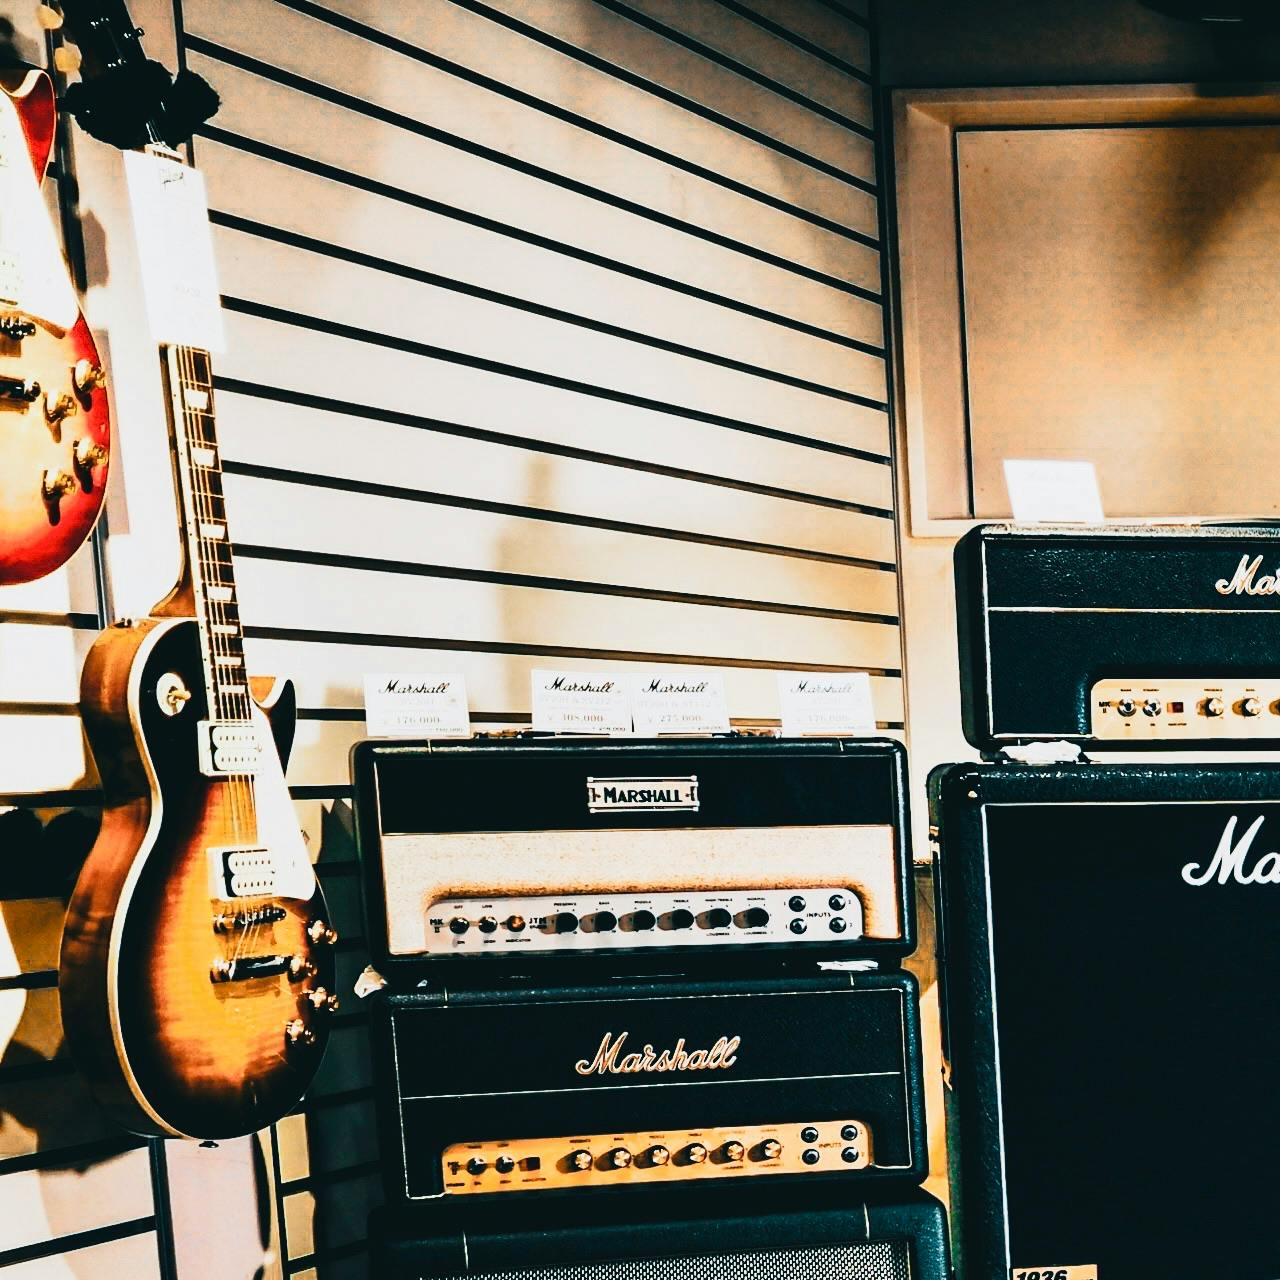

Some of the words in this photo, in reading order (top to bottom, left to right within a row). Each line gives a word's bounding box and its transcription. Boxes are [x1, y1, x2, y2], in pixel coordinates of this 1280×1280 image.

[378, 679, 451, 694] Marshall
[544, 676, 615, 694] Marshall
[642, 678, 709, 694] Marshall
[603, 786, 683, 804] MARSHALL
[575, 1031, 741, 1075] Marshall
